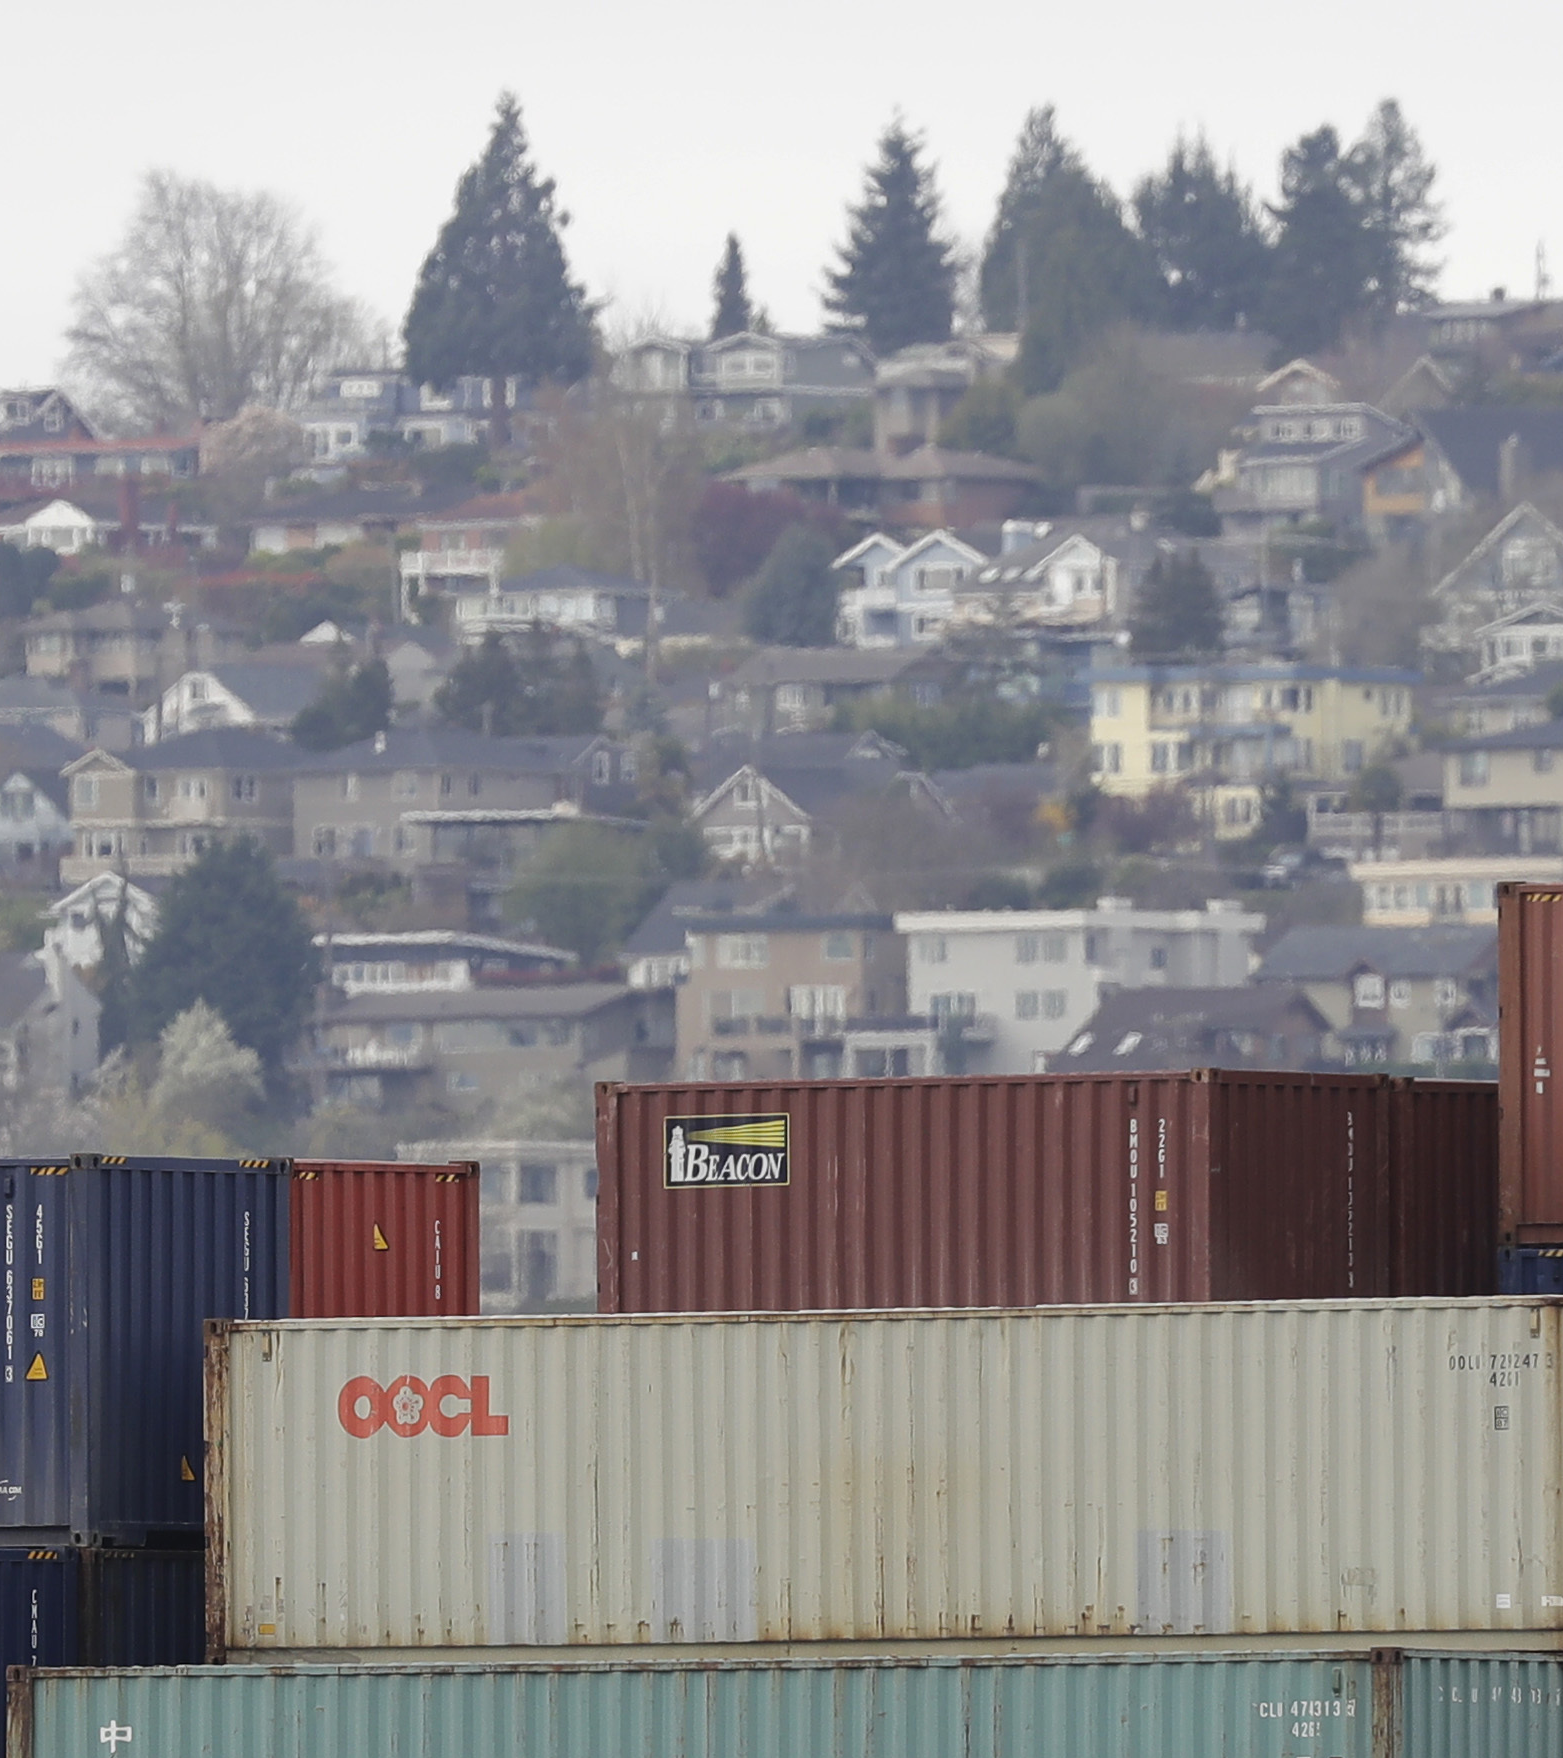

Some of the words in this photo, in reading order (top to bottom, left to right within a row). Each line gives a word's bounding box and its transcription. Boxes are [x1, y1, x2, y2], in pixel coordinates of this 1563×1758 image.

[685, 1144, 784, 1182] BEACON
[1129, 1119, 1138, 1178] BMOU
[1158, 1118, 1166, 1178] 22G1
[35, 1204, 43, 1265] 45G1
[1129, 1183, 1137, 1273] 105210
[5, 1365, 13, 1382] 3
[338, 1374, 509, 1439] OOCL
[1252, 1701, 1283, 1718] CLU
